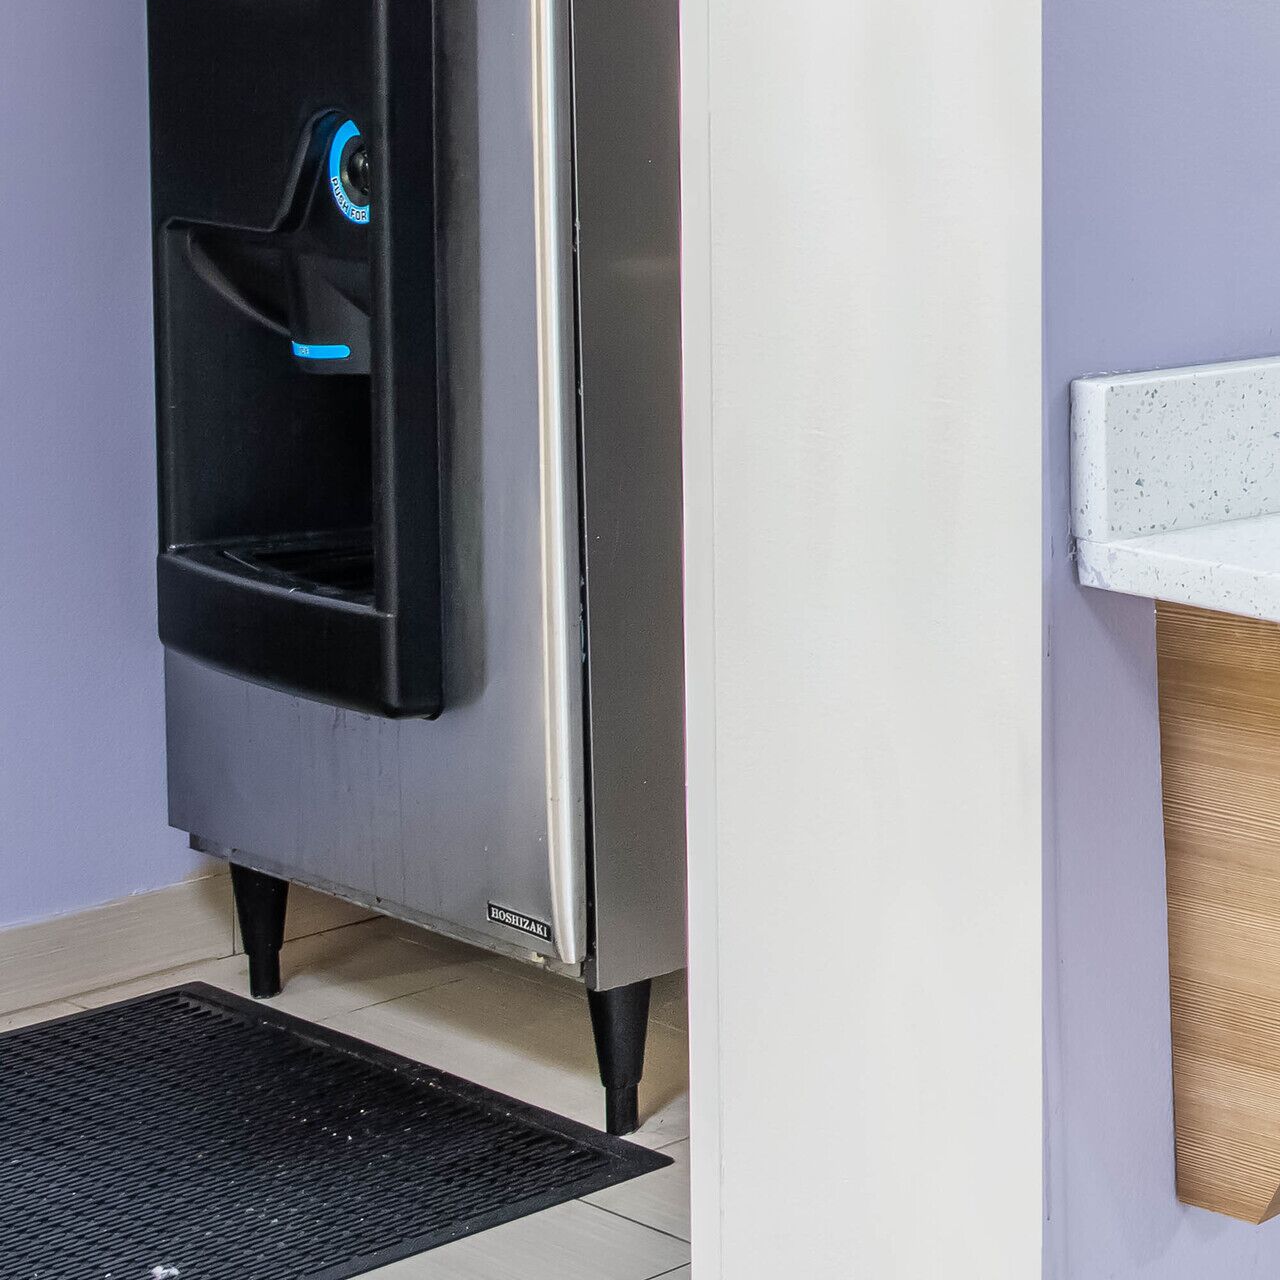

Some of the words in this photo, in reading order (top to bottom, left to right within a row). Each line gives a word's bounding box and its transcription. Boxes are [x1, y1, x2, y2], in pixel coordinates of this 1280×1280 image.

[331, 176, 349, 212] PUSH
[350, 208, 368, 221] FOR
[490, 906, 549, 938] HOSHIZAKI
